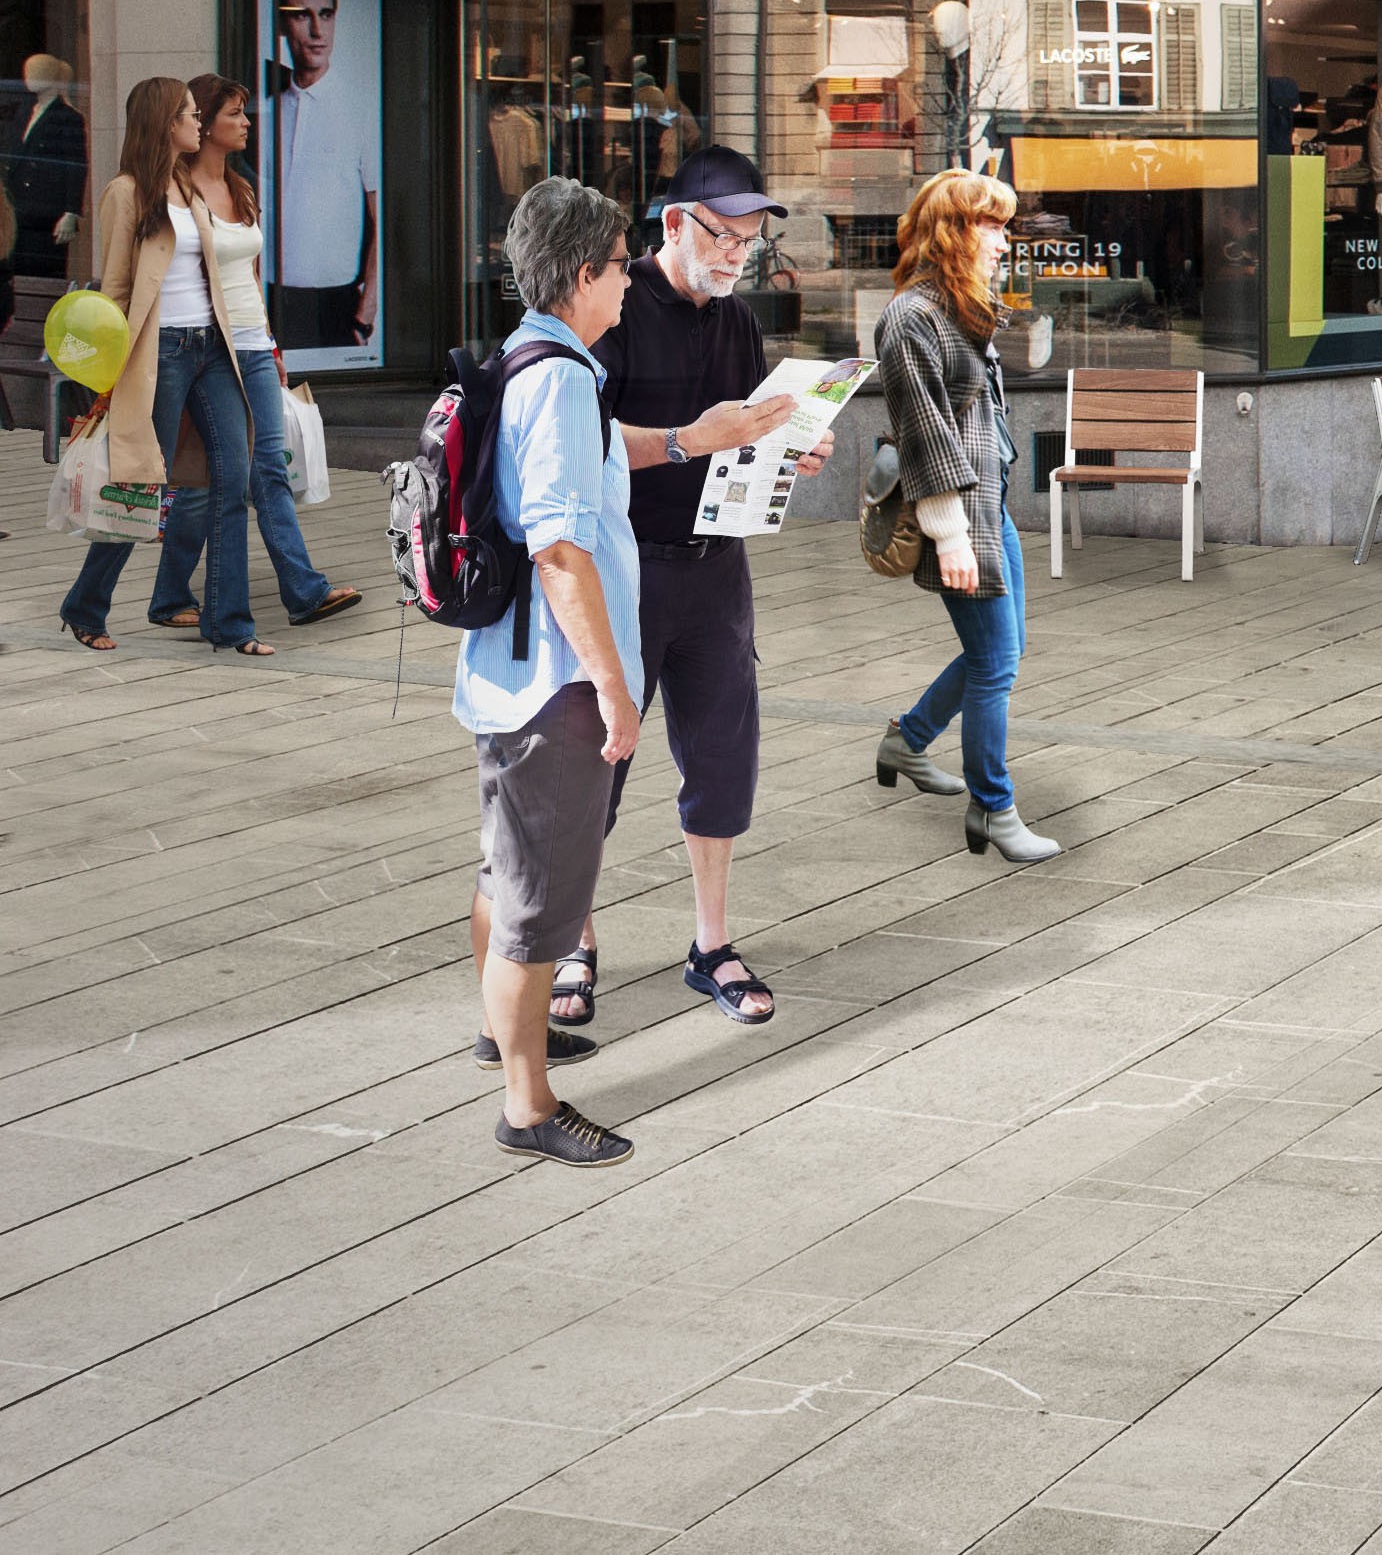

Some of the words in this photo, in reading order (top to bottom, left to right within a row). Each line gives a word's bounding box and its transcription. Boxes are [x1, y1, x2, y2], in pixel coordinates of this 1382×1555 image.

[1039, 48, 1113, 64] LACOSTE
[1007, 242, 1081, 257] RING
[1094, 242, 1122, 257] 19
[1345, 239, 1378, 253] NEW
[999, 261, 1100, 276] ECTION
